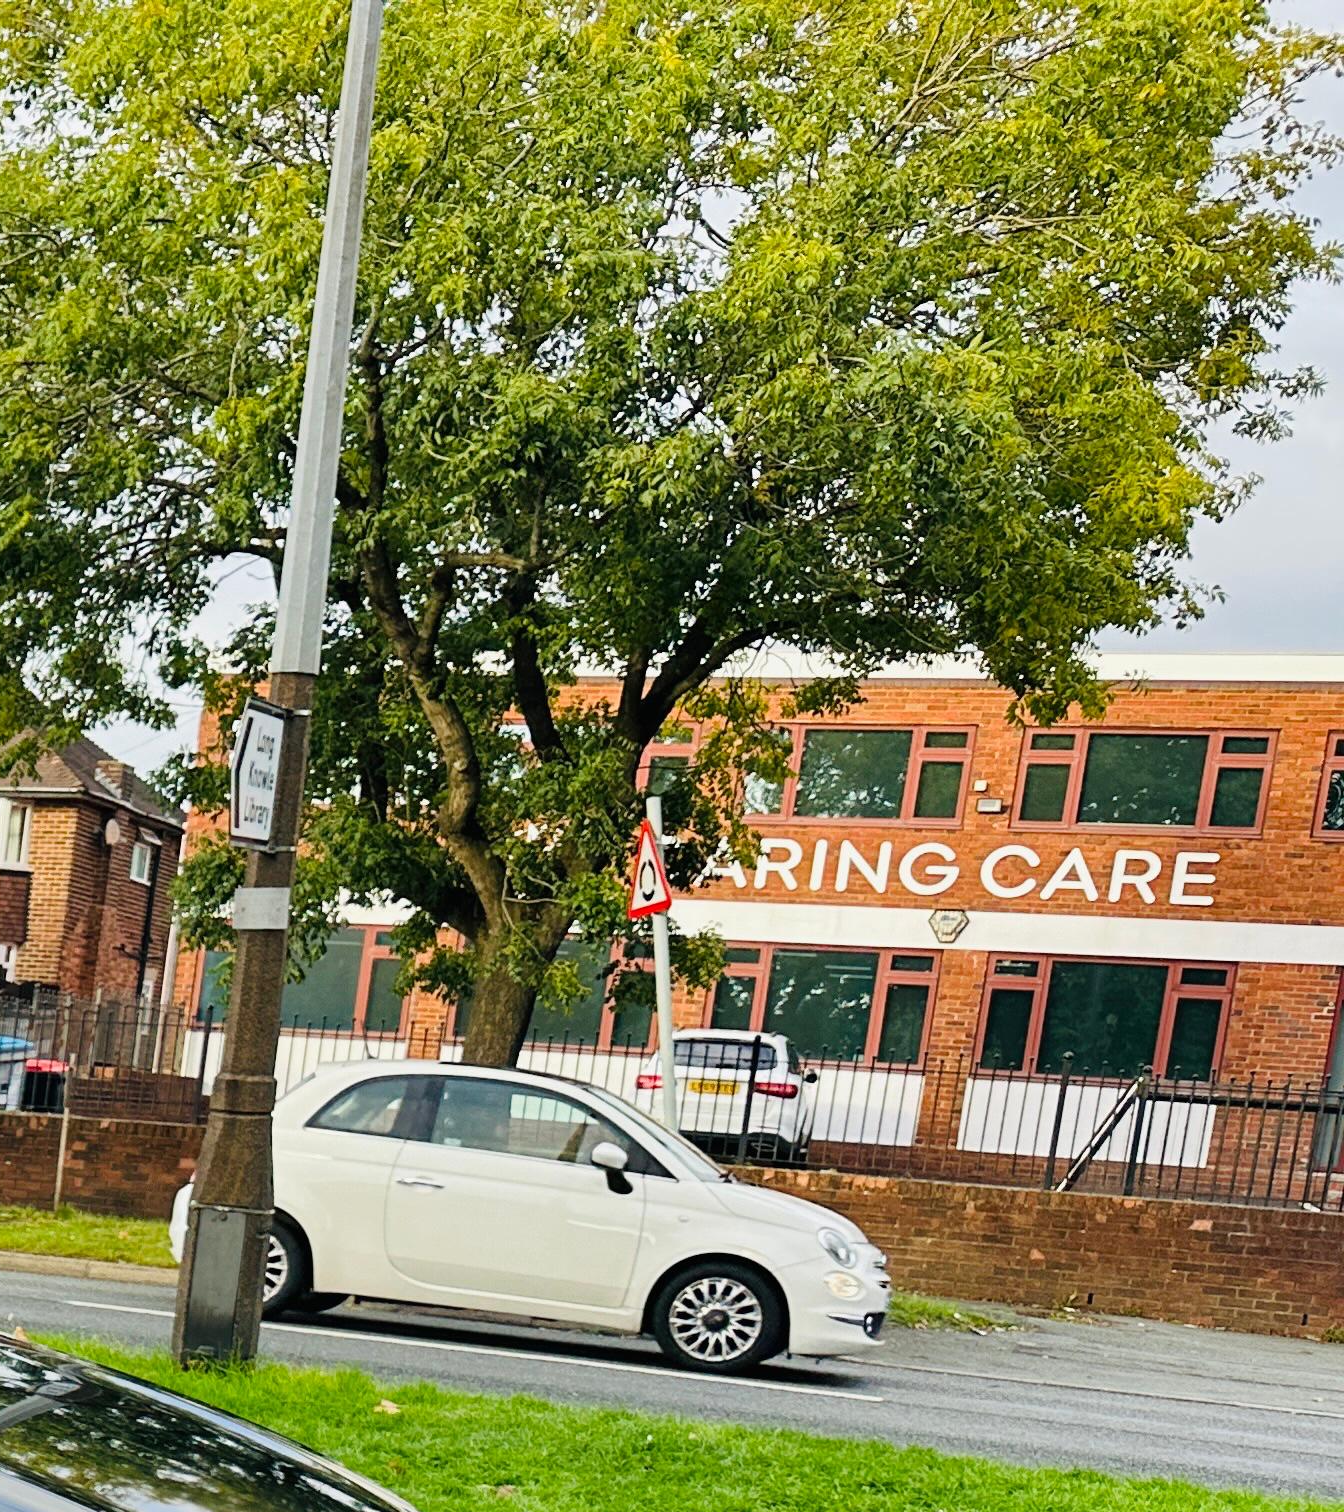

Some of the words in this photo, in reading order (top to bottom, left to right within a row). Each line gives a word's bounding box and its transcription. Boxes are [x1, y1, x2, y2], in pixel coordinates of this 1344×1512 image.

[256, 726, 275, 760] Long
[248, 760, 274, 792] Knowle
[243, 796, 270, 831] Library
[979, 844, 1223, 907] CARE
